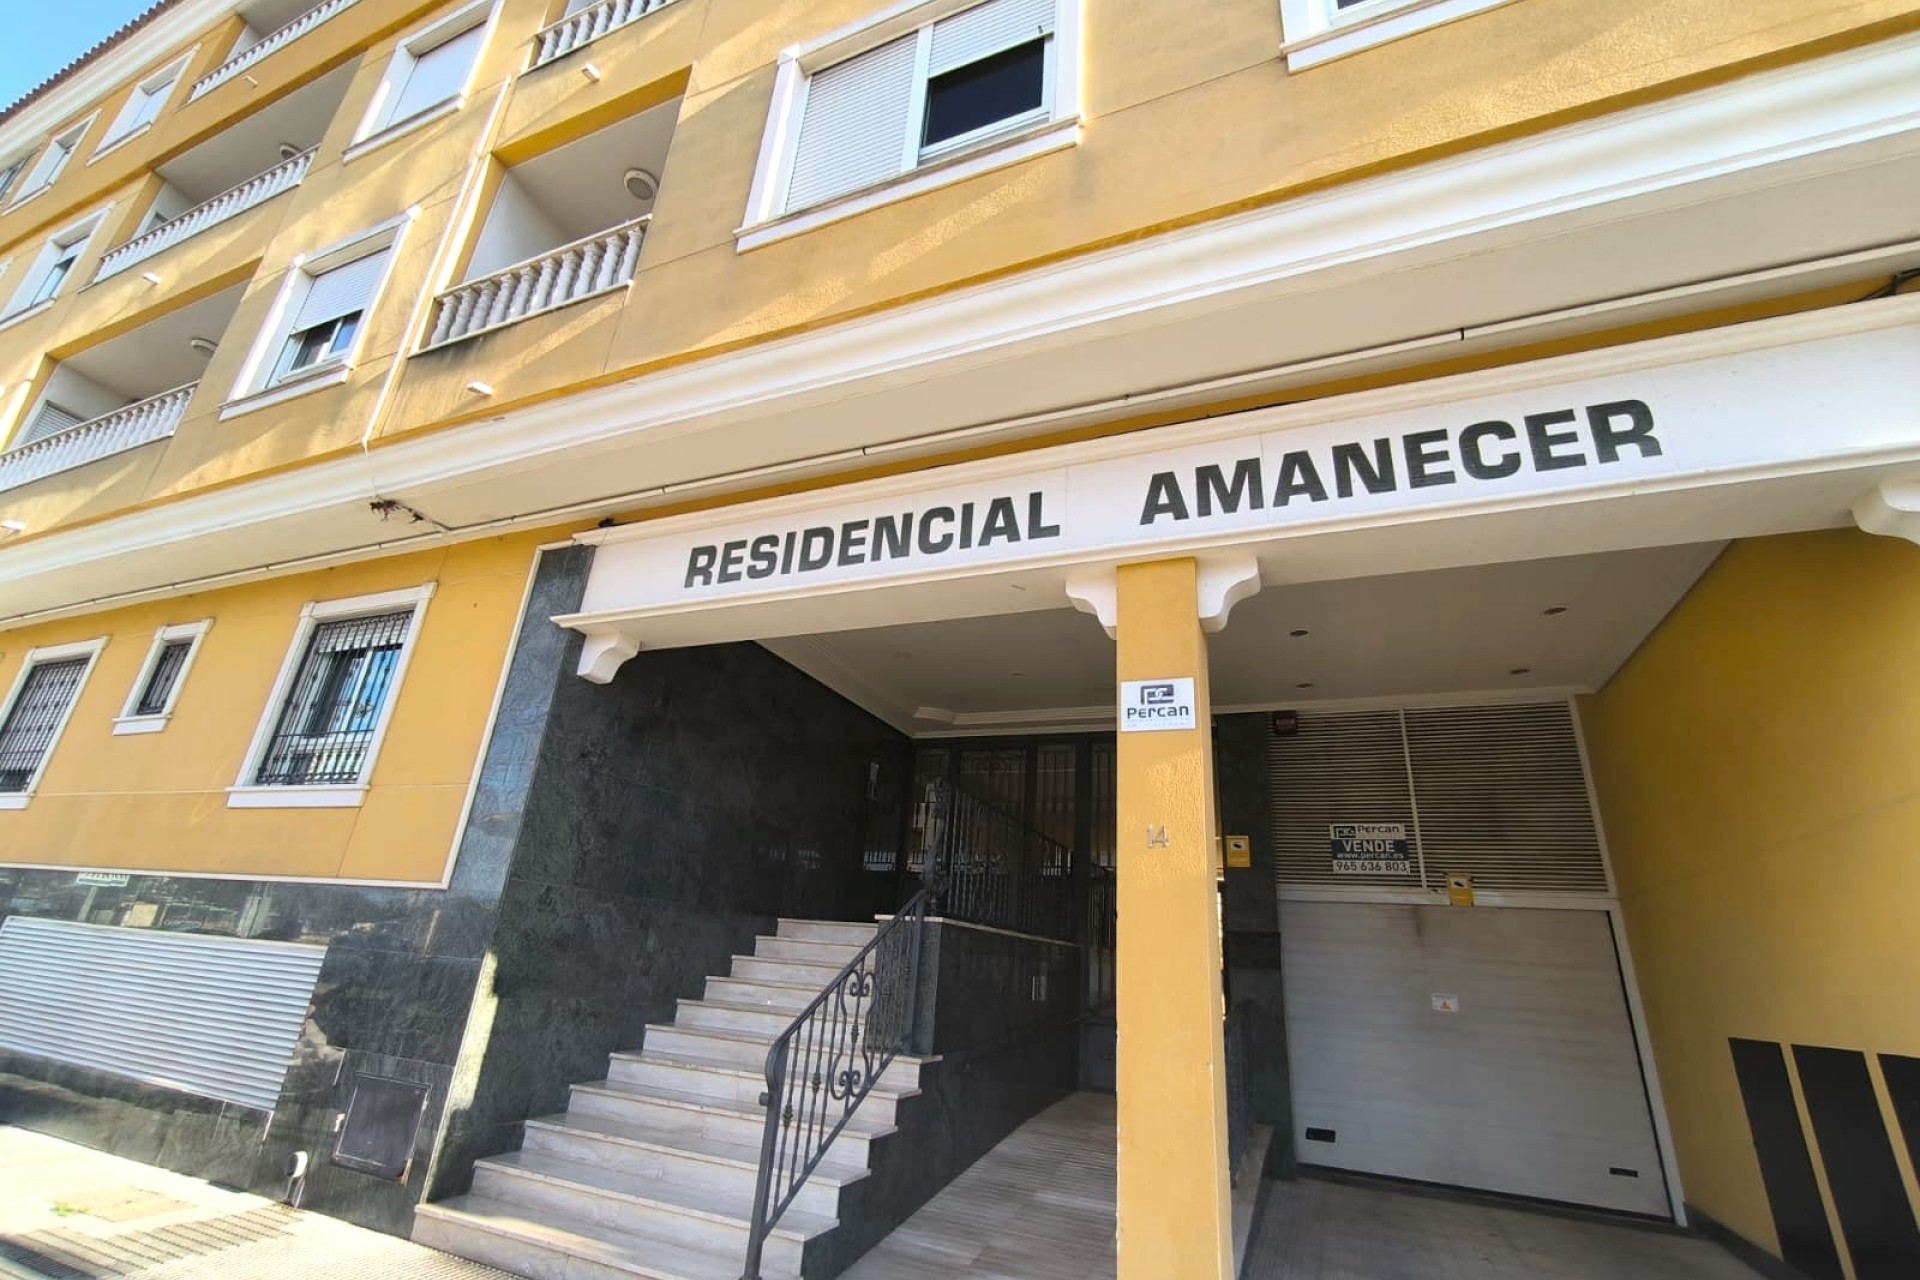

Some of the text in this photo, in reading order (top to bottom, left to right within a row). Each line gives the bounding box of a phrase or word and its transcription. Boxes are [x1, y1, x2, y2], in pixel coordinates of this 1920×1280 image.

[684, 398, 1662, 588] RESIDENCIAL AMANECER
[1127, 705, 1189, 719] Percan
[1357, 825, 1399, 833] Percan
[1146, 823, 1170, 849] 14
[1342, 840, 1396, 852] VENDE
[1336, 861, 1407, 871] 965 636 803
